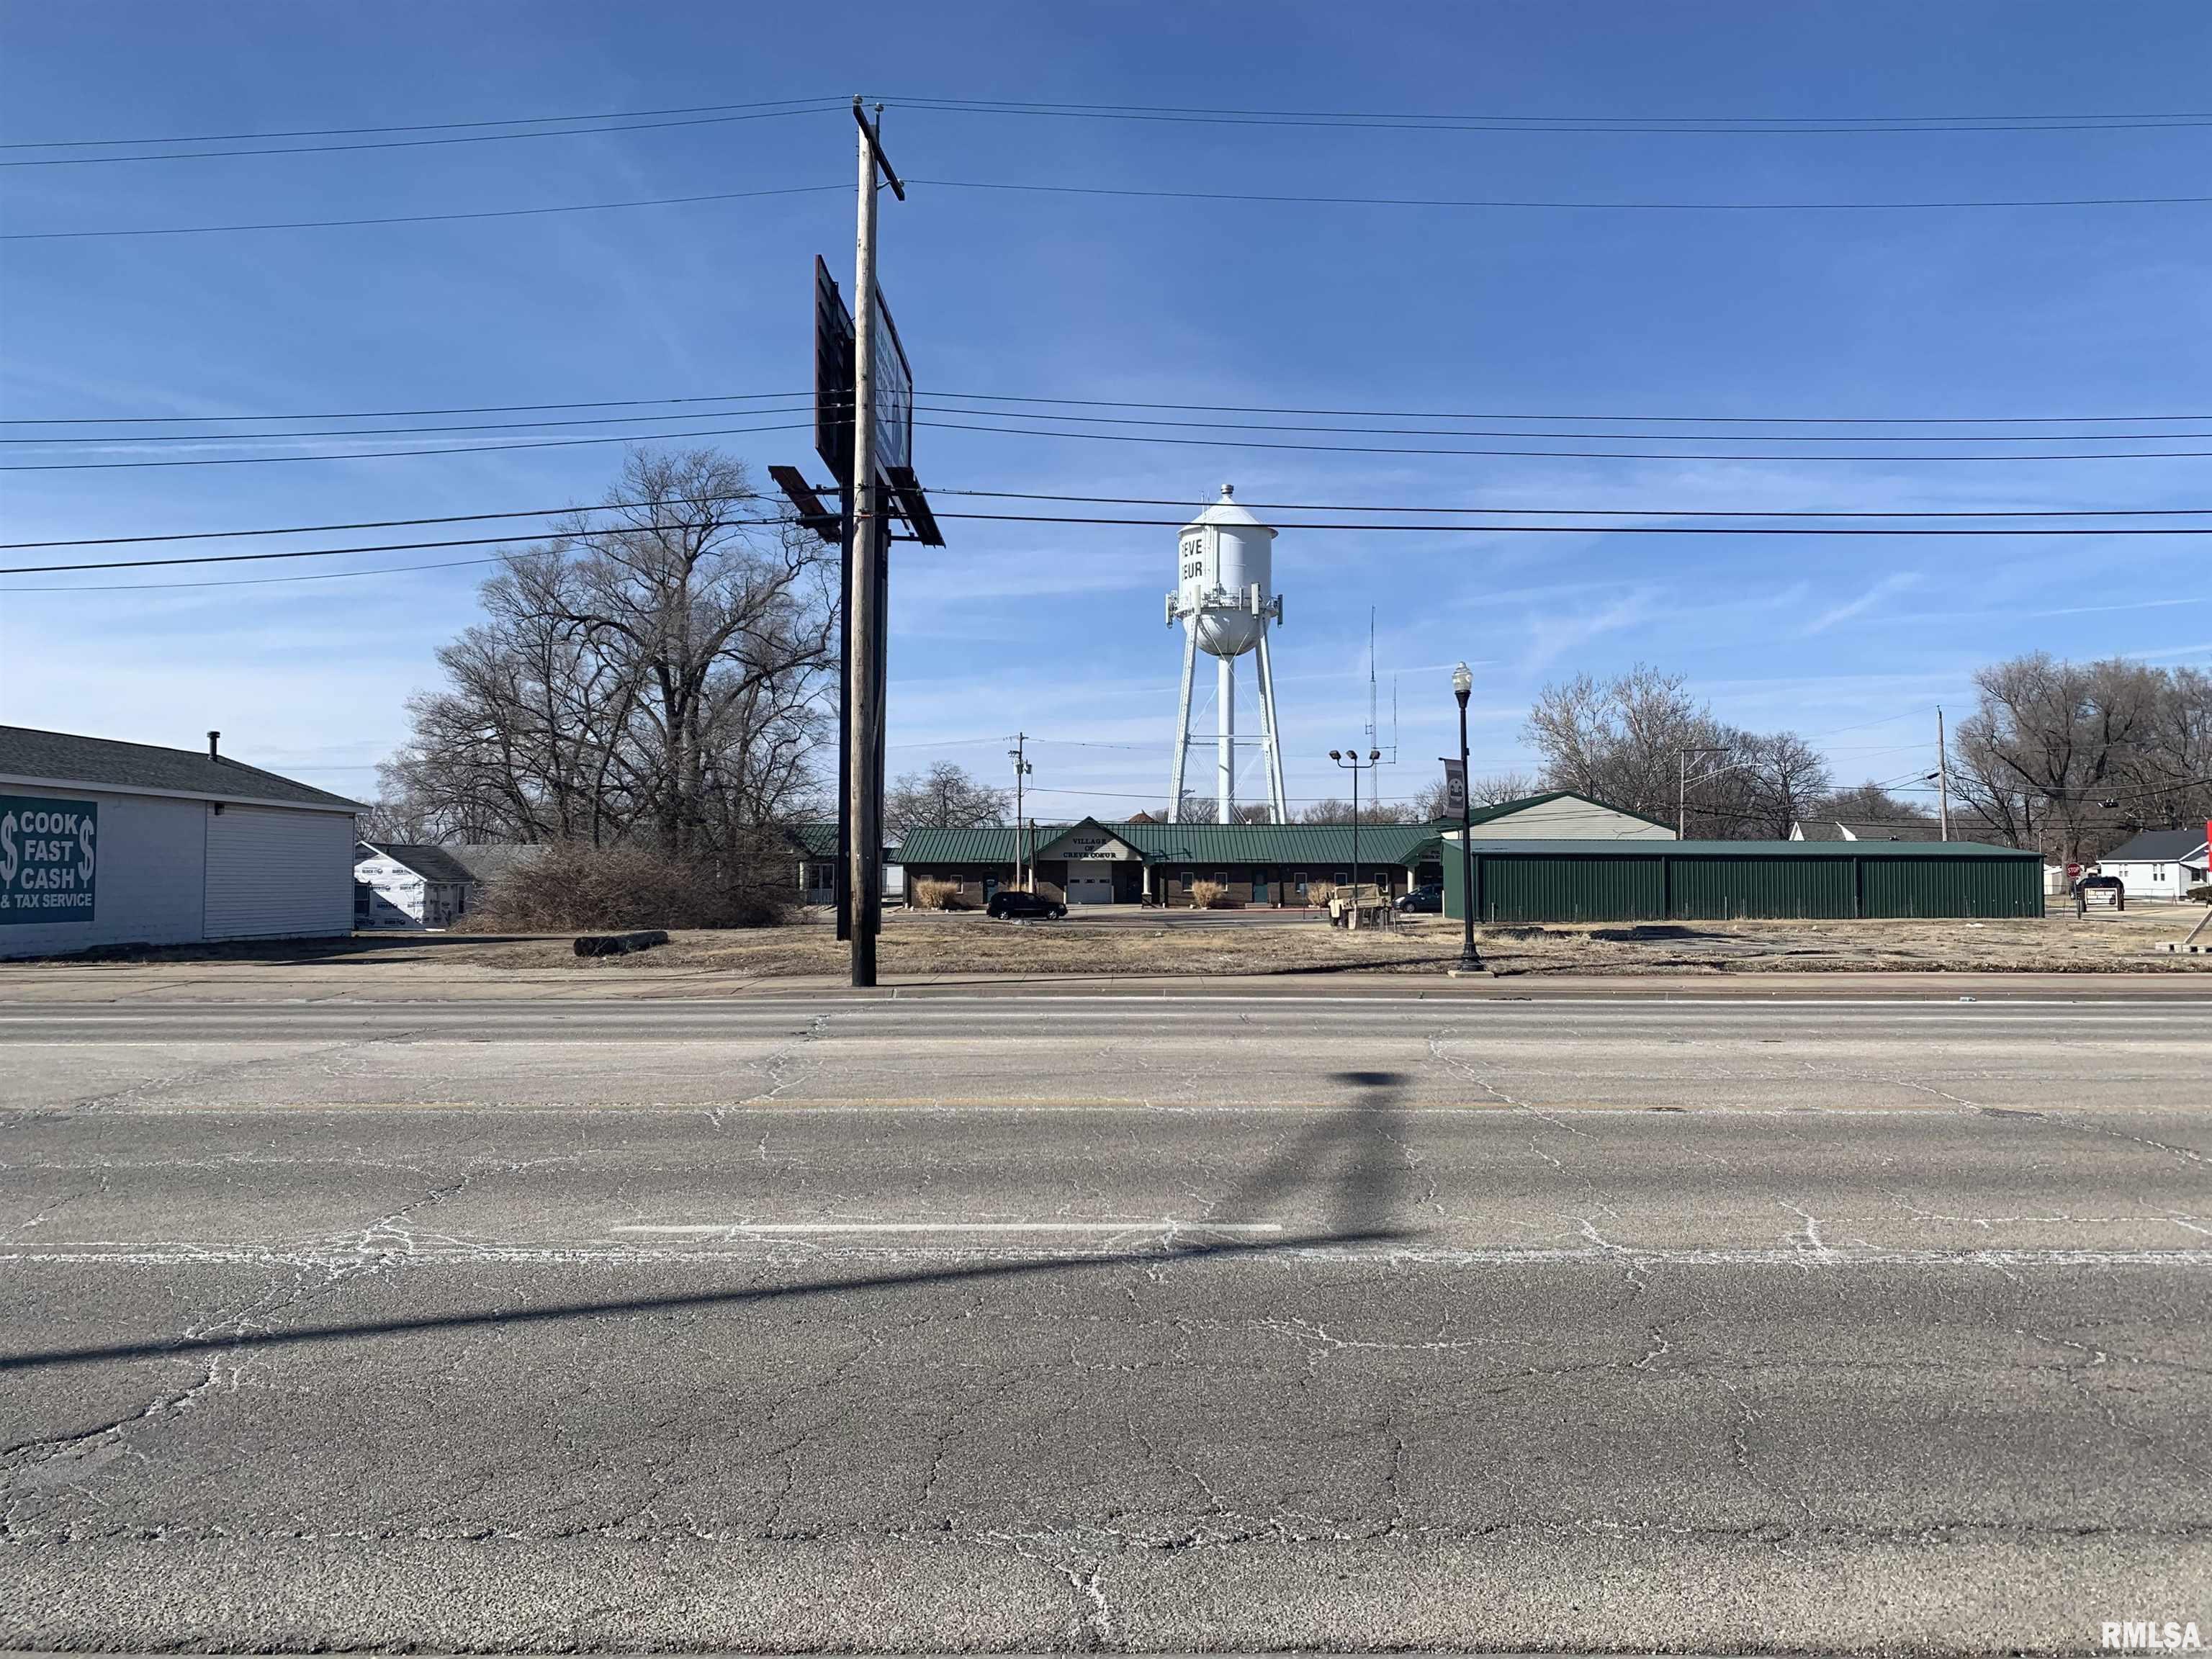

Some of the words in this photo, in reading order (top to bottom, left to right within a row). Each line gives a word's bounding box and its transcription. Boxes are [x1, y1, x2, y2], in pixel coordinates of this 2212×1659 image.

[20, 811, 78, 835] COOK
[24, 840, 74, 861] FAST
[20, 868, 75, 889] CASH
[1, 894, 10, 908] &
[14, 894, 39, 908] TAX
[42, 893, 92, 907] SERVICE
